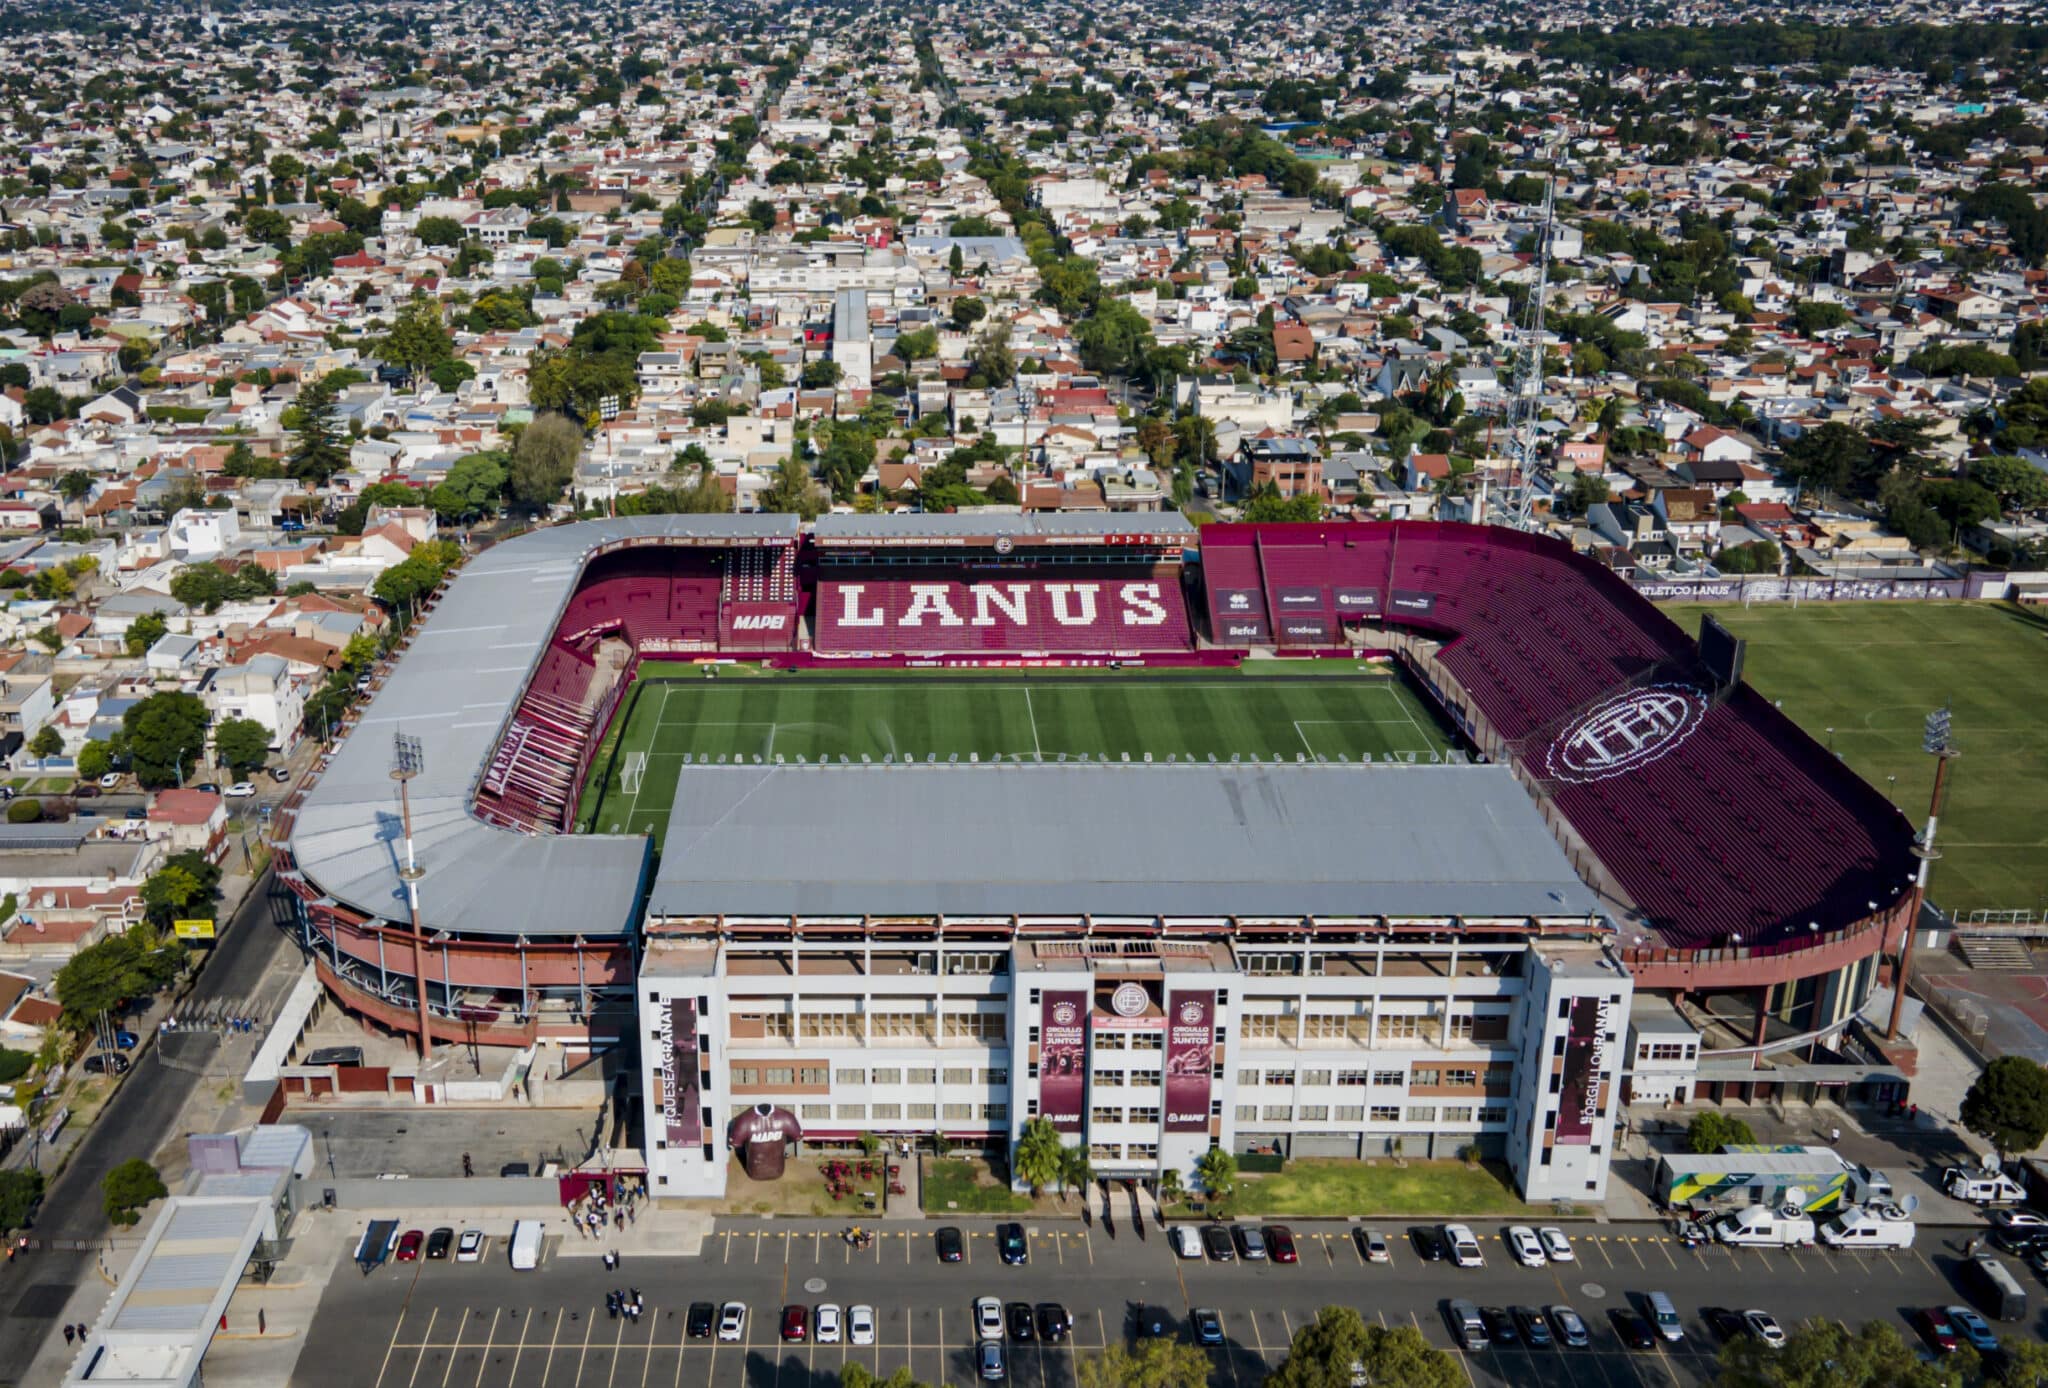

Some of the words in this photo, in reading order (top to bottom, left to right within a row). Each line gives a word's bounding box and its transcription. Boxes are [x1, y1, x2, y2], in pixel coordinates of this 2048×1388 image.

[1693, 585, 1730, 595] LANUS
[838, 584, 1167, 626] LANUS
[733, 615, 785, 630] MAPEI
[495, 730, 524, 766] BARRA
[487, 764, 507, 783] LA
[1046, 1037, 1082, 1045] JUNTOS
[1173, 1037, 1209, 1045] JUNTOS
[660, 996, 682, 1127] #QUESEAGRANATE
[750, 1131, 783, 1143] MAPEI
